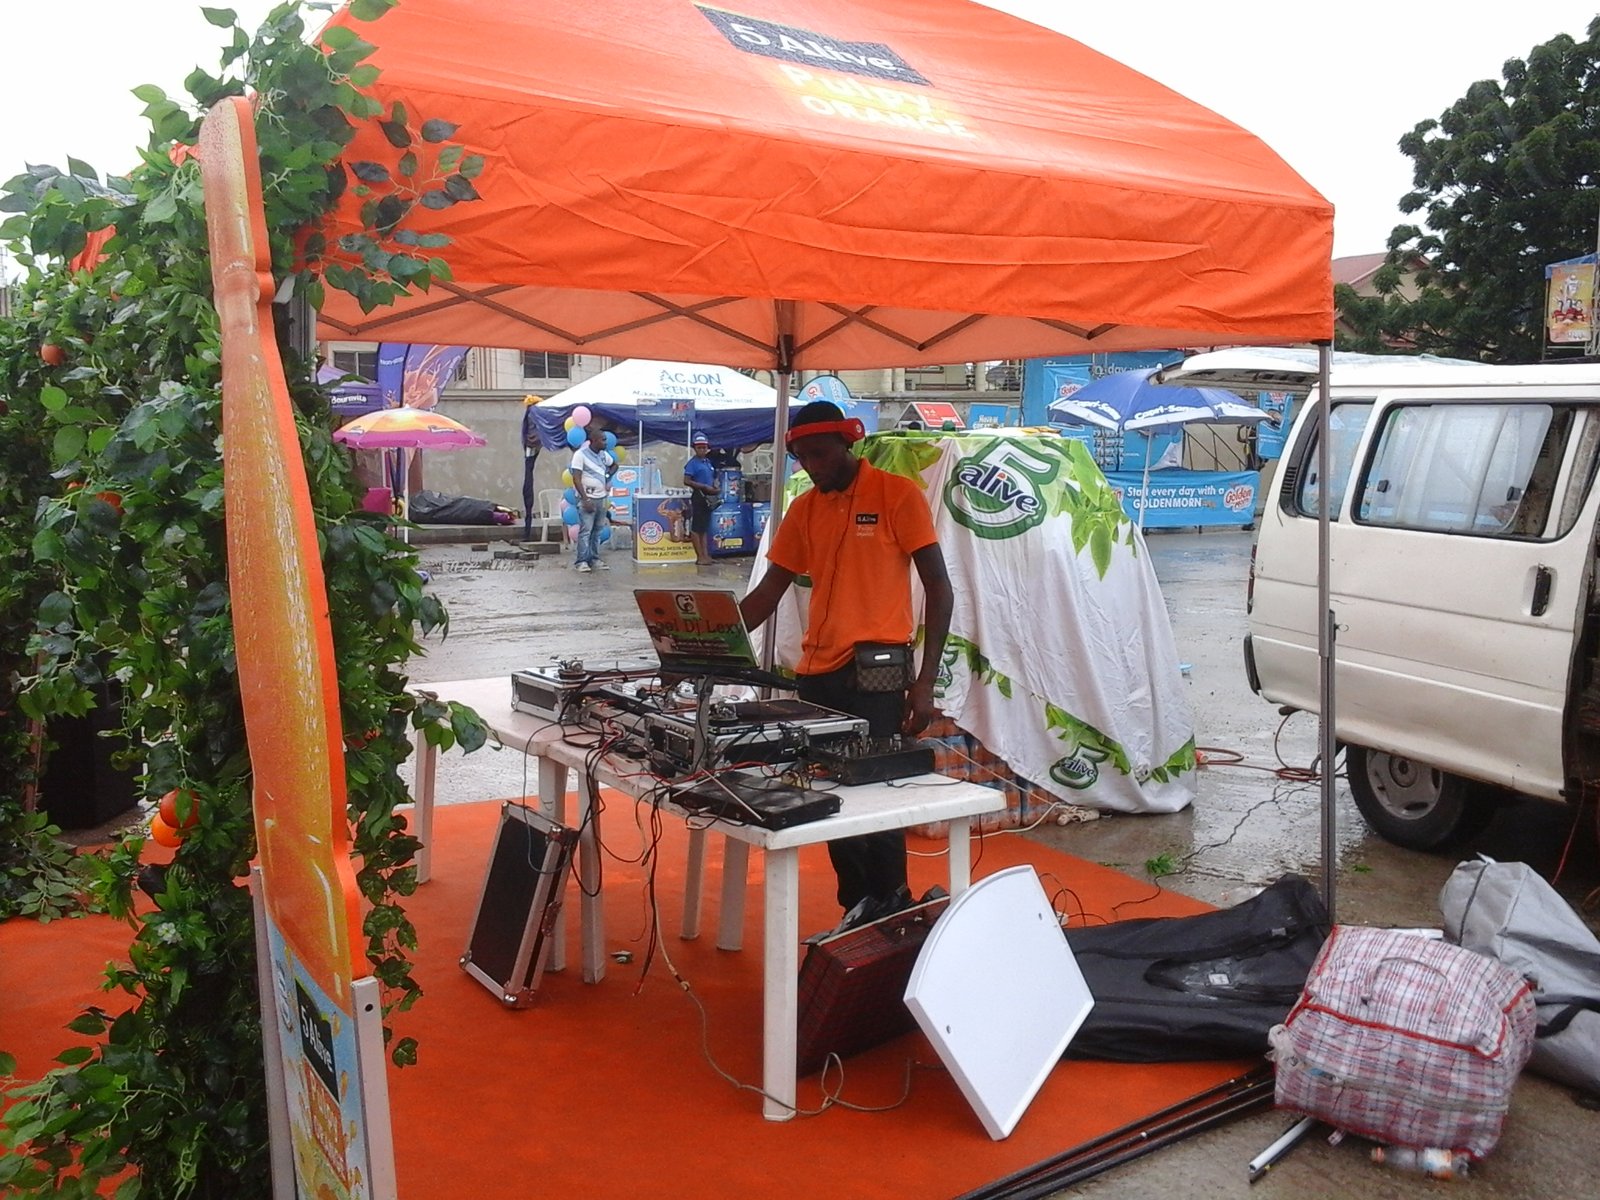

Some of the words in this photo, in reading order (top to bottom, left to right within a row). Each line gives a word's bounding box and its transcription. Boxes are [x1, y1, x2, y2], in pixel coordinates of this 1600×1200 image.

[730, 22, 771, 46] 5
[779, 34, 898, 71] Alive
[661, 383, 725, 398] RENTALS
[959, 463, 1040, 515] alive
[1127, 486, 1149, 497] Stat
[1151, 488, 1177, 498] every
[1179, 486, 1196, 498] day
[1198, 485, 1216, 496] with
[308, 1024, 334, 1072] Alive
